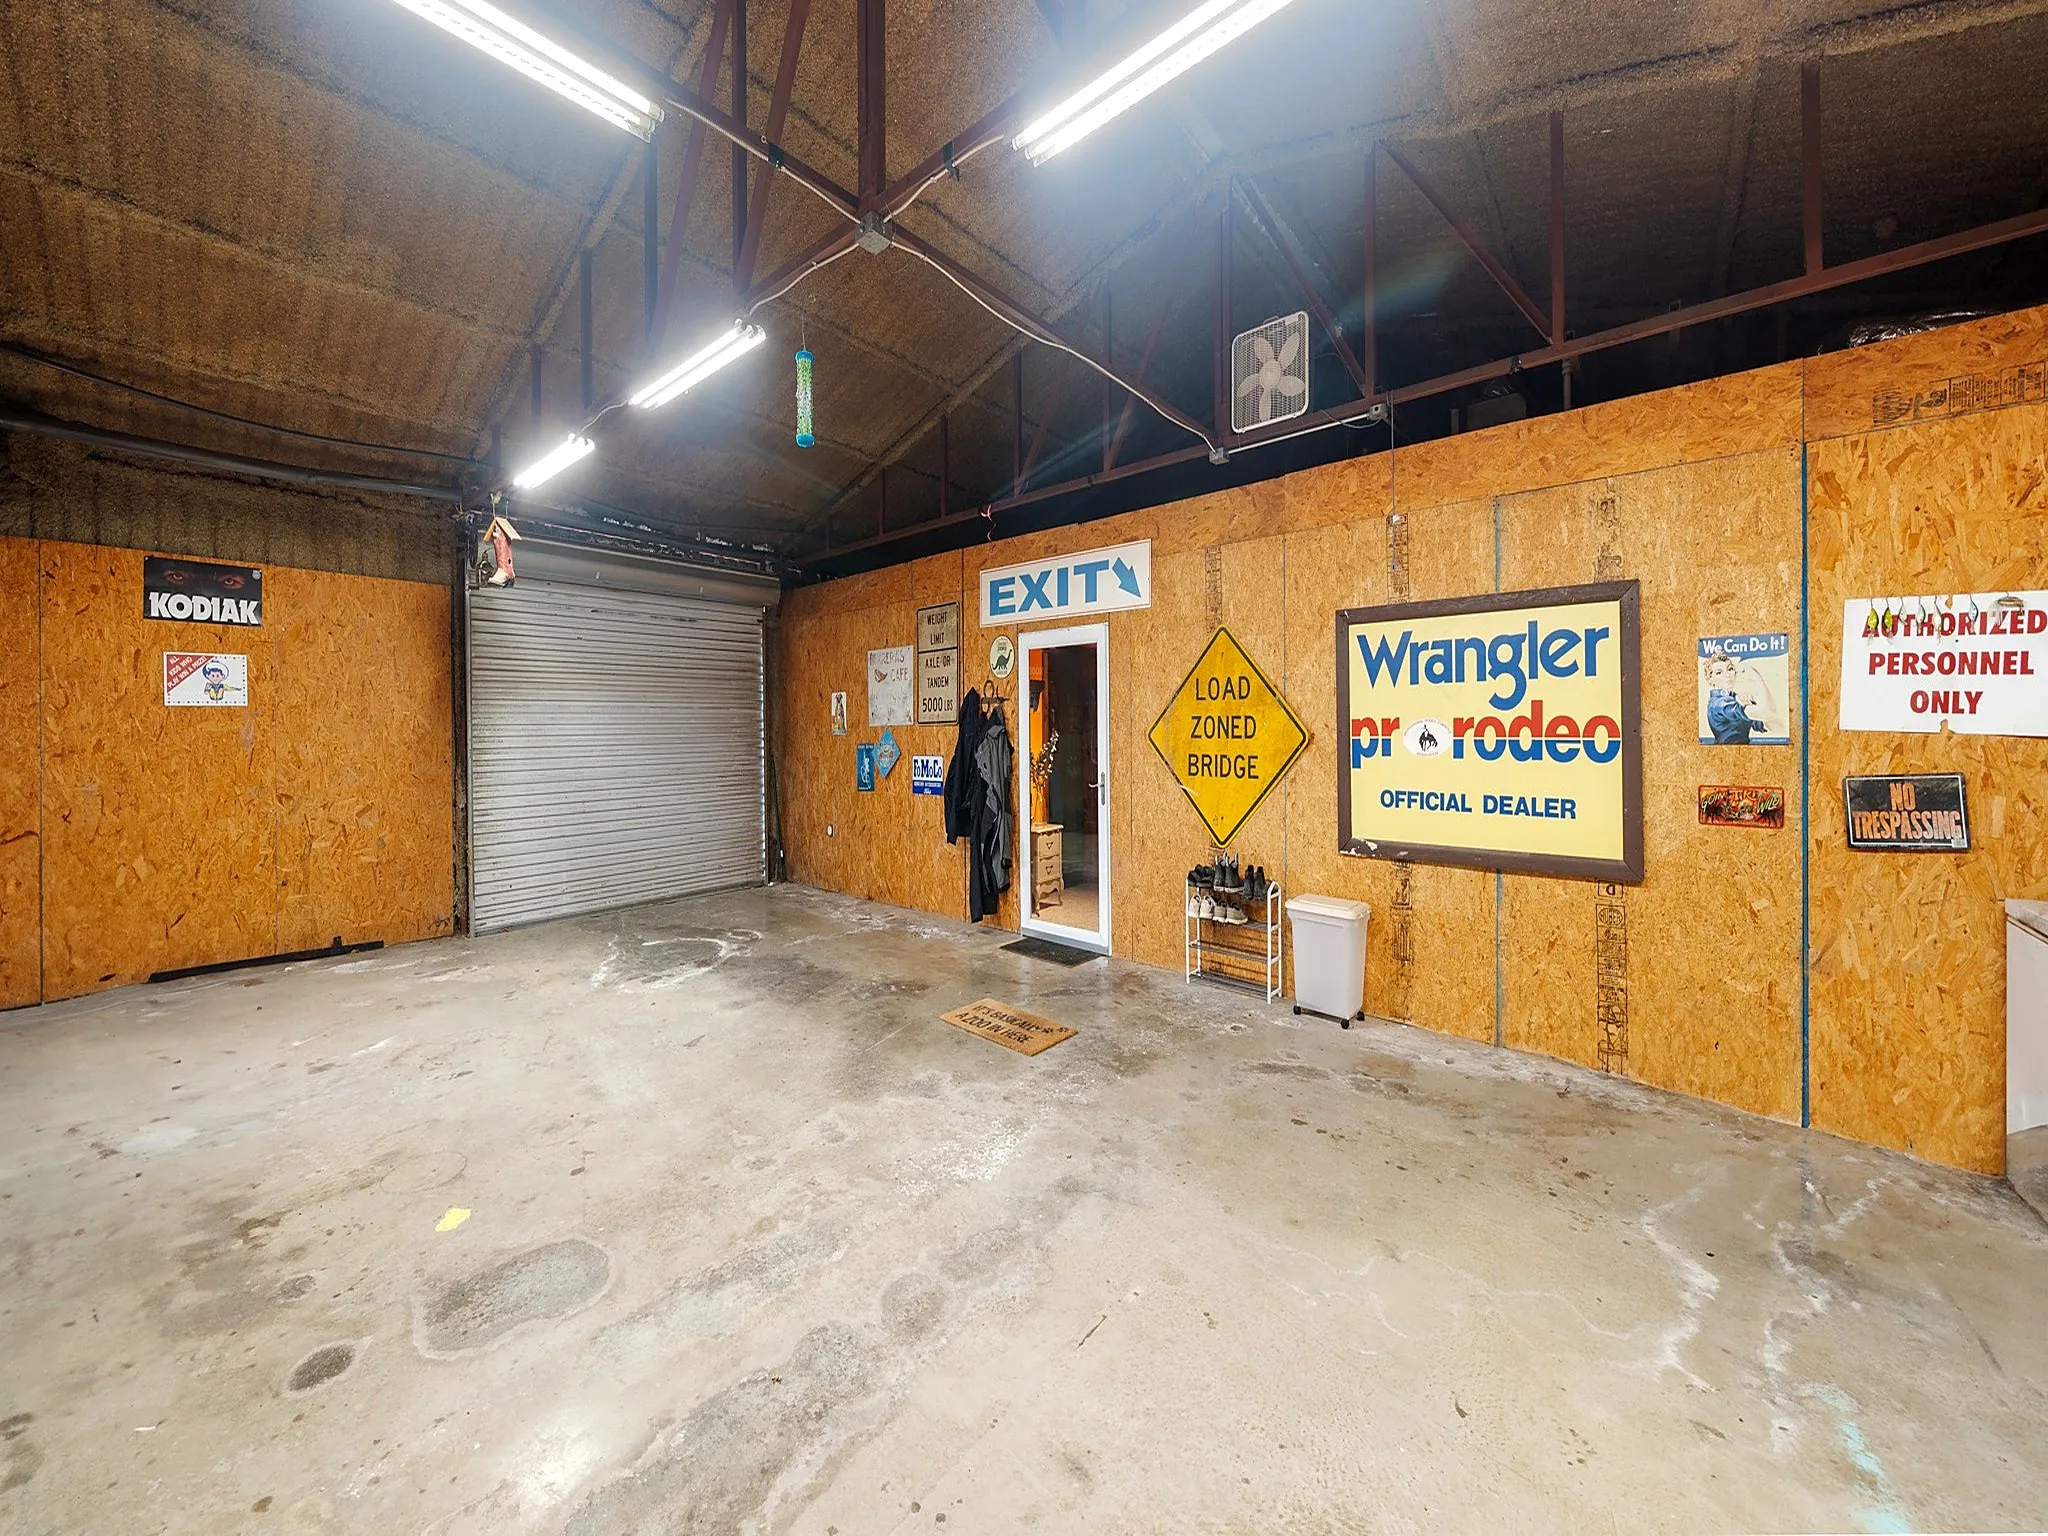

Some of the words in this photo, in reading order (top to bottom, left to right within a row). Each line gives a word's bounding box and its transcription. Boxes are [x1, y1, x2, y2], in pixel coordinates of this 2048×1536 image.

[989, 559, 1109, 616] EXIT
[149, 591, 259, 625] KODIAK
[926, 611, 948, 625] WEIGHT
[1861, 609, 2048, 639] AUTHORIZED
[930, 632, 944, 645] LIMIT
[1703, 640, 1723, 654] We
[1724, 638, 1747, 653] Can
[1750, 637, 1768, 652] Do
[1771, 635, 1785, 650] It!
[168, 666, 182, 677] KIDS
[180, 656, 193, 668] WHO
[169, 655, 180, 665] ALL
[925, 657, 940, 669] AXLE
[942, 655, 951, 668] OR
[1357, 619, 1609, 711] Wrangler
[1868, 650, 2034, 675] PERSONNEL
[167, 677, 179, 688] PLAY
[178, 668, 190, 679] WIN
[890, 668, 909, 682] CAFE
[927, 675, 949, 688] TANDEM
[1195, 676, 1251, 701] LOAD
[922, 696, 943, 713] 5000
[944, 699, 954, 712] LBS
[1910, 690, 1984, 715] ONLY
[1190, 715, 1257, 740] ZONED
[1453, 699, 1621, 763] rodeo
[913, 758, 942, 778] FoMoCo
[1187, 753, 1259, 779] BRIDGE
[1380, 789, 1473, 813] OFFICIAL
[1483, 794, 1577, 820] DEALER
[1757, 791, 1780, 814] WILD
[1889, 782, 1916, 811] NO
[1853, 810, 1962, 840] TRESPASSING
[955, 1012, 968, 1020] A
[961, 1015, 992, 1029] ZOO
[972, 1004, 994, 1015] IT'S
[989, 1010, 1041, 1034] BASICALLY
[986, 1023, 1003, 1033] IN
[999, 1028, 1034, 1044] HERE
